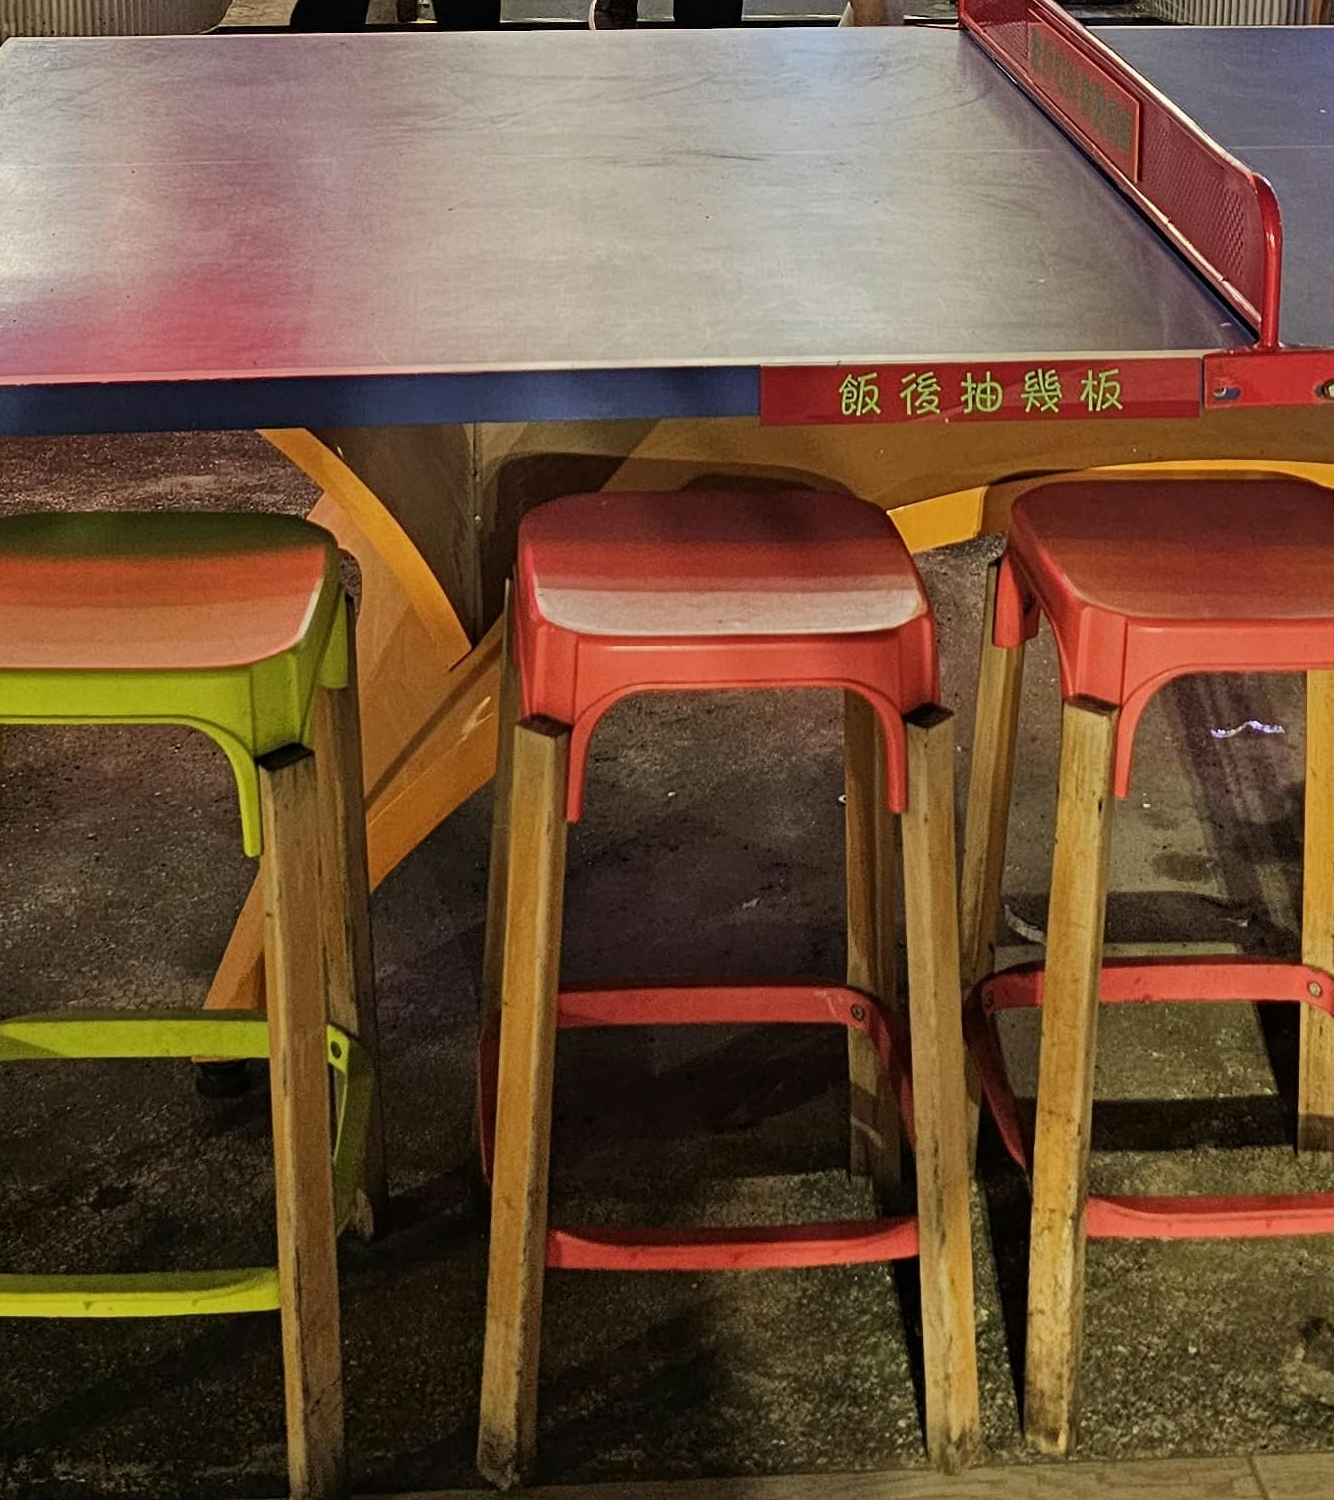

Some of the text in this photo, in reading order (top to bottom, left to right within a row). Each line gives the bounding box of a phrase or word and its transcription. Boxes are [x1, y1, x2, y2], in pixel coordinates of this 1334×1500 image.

[837, 370, 1124, 415] 飯後抽幾板
